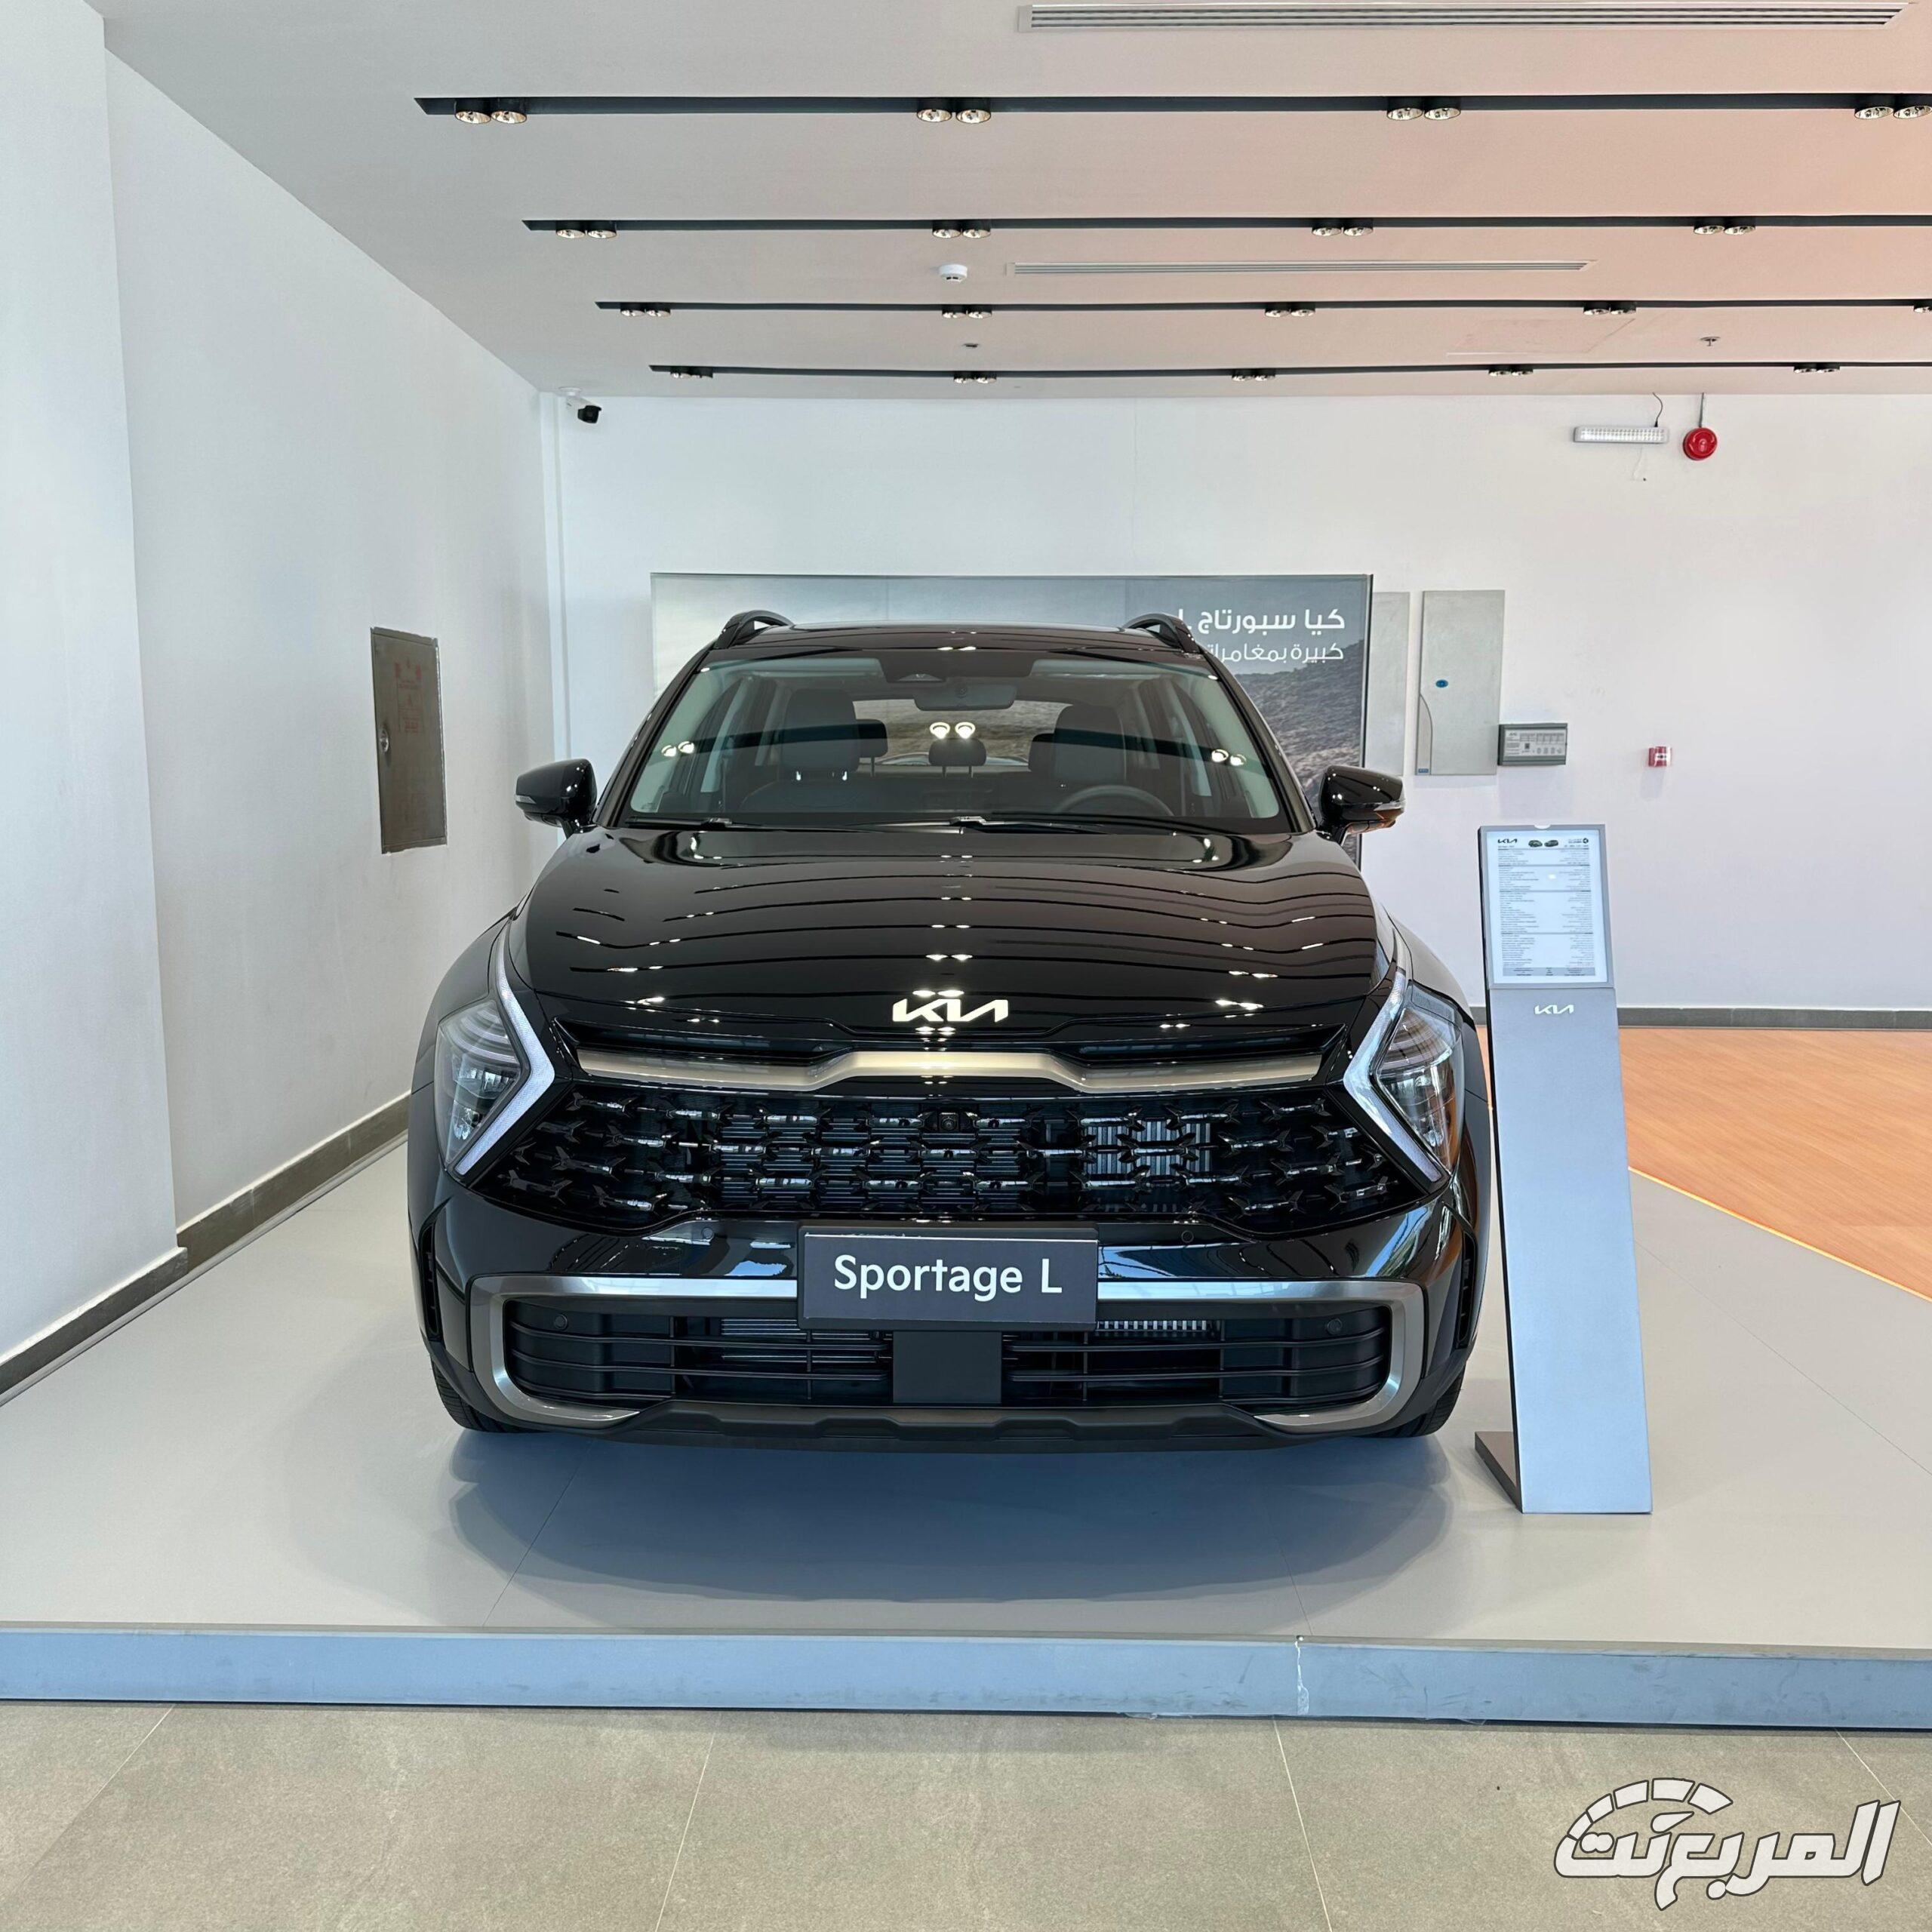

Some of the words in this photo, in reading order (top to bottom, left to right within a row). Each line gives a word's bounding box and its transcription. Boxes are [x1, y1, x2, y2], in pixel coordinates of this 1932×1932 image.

[1198, 609, 1296, 635] سبورتاج
[1304, 608, 1345, 635] كيا
[1290, 642, 1344, 663] كبيرة
[892, 998, 1009, 1023] KIA
[1534, 1004, 1574, 1015] KIA
[834, 1254, 1023, 1302] Sportage
[1041, 1258, 1063, 1294] L
